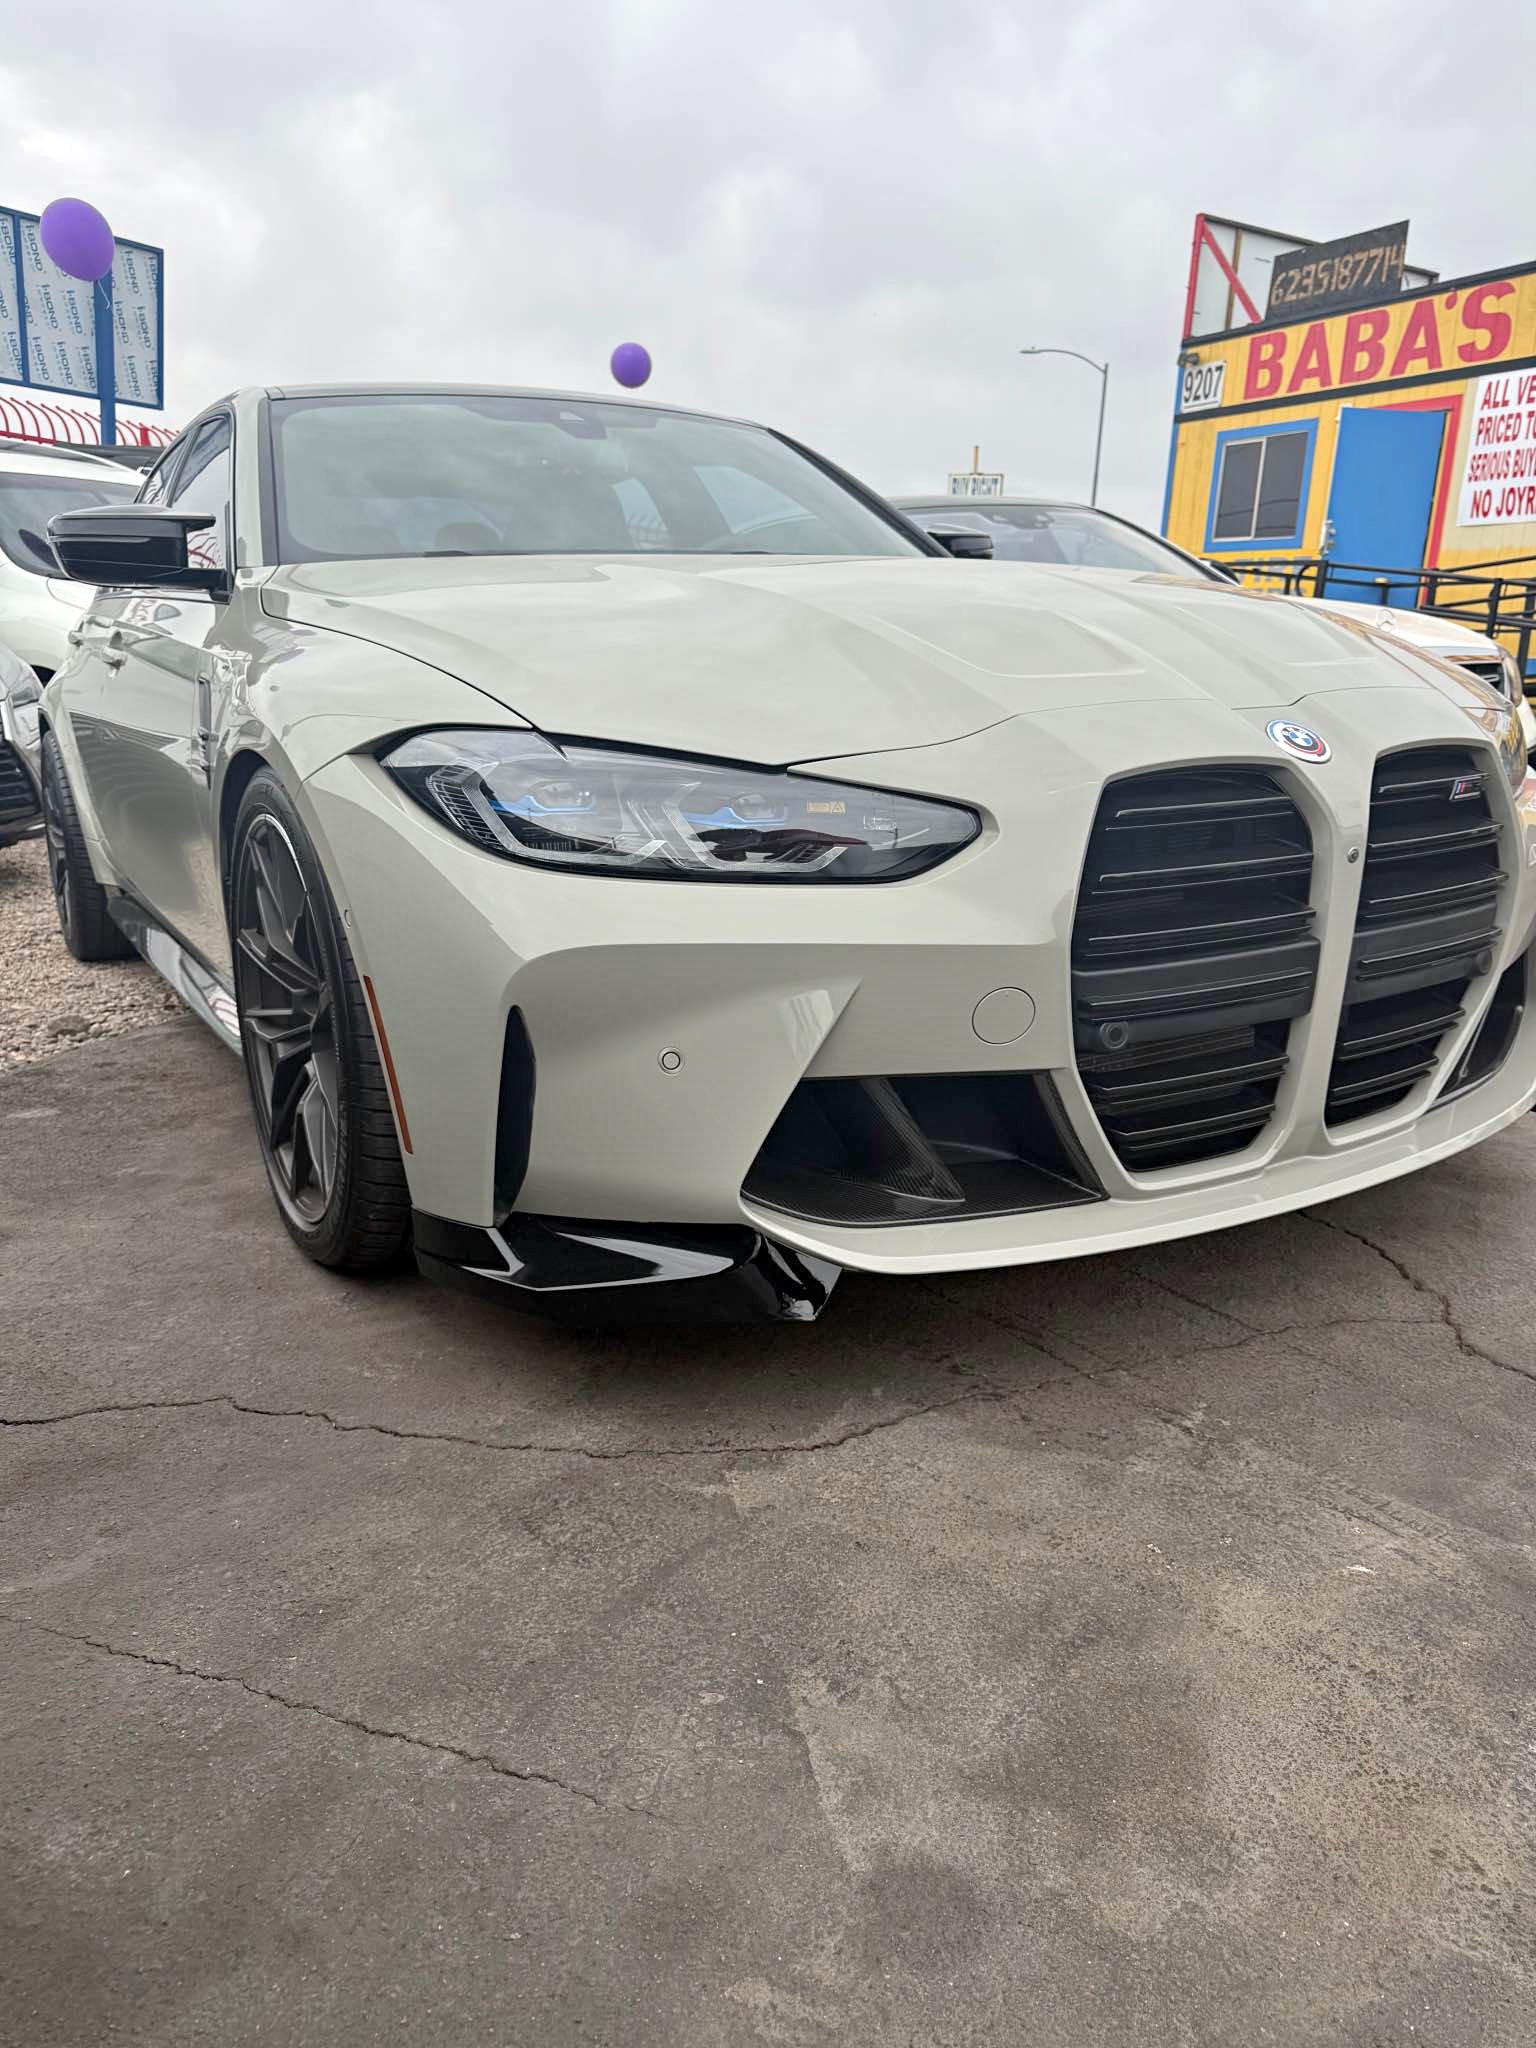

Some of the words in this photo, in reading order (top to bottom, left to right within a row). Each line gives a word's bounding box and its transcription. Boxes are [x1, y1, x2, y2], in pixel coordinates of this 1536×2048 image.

[1270, 241, 1406, 305] 6235187714
[1243, 281, 1517, 401] BABA'S
[1184, 364, 1223, 403] 9207
[1481, 379, 1510, 411] ALL
[1475, 412, 1522, 446] PRICED
[1468, 450, 1511, 482] SERIOUS
[1512, 447, 1536, 478] BUY
[1470, 489, 1493, 519] NO
